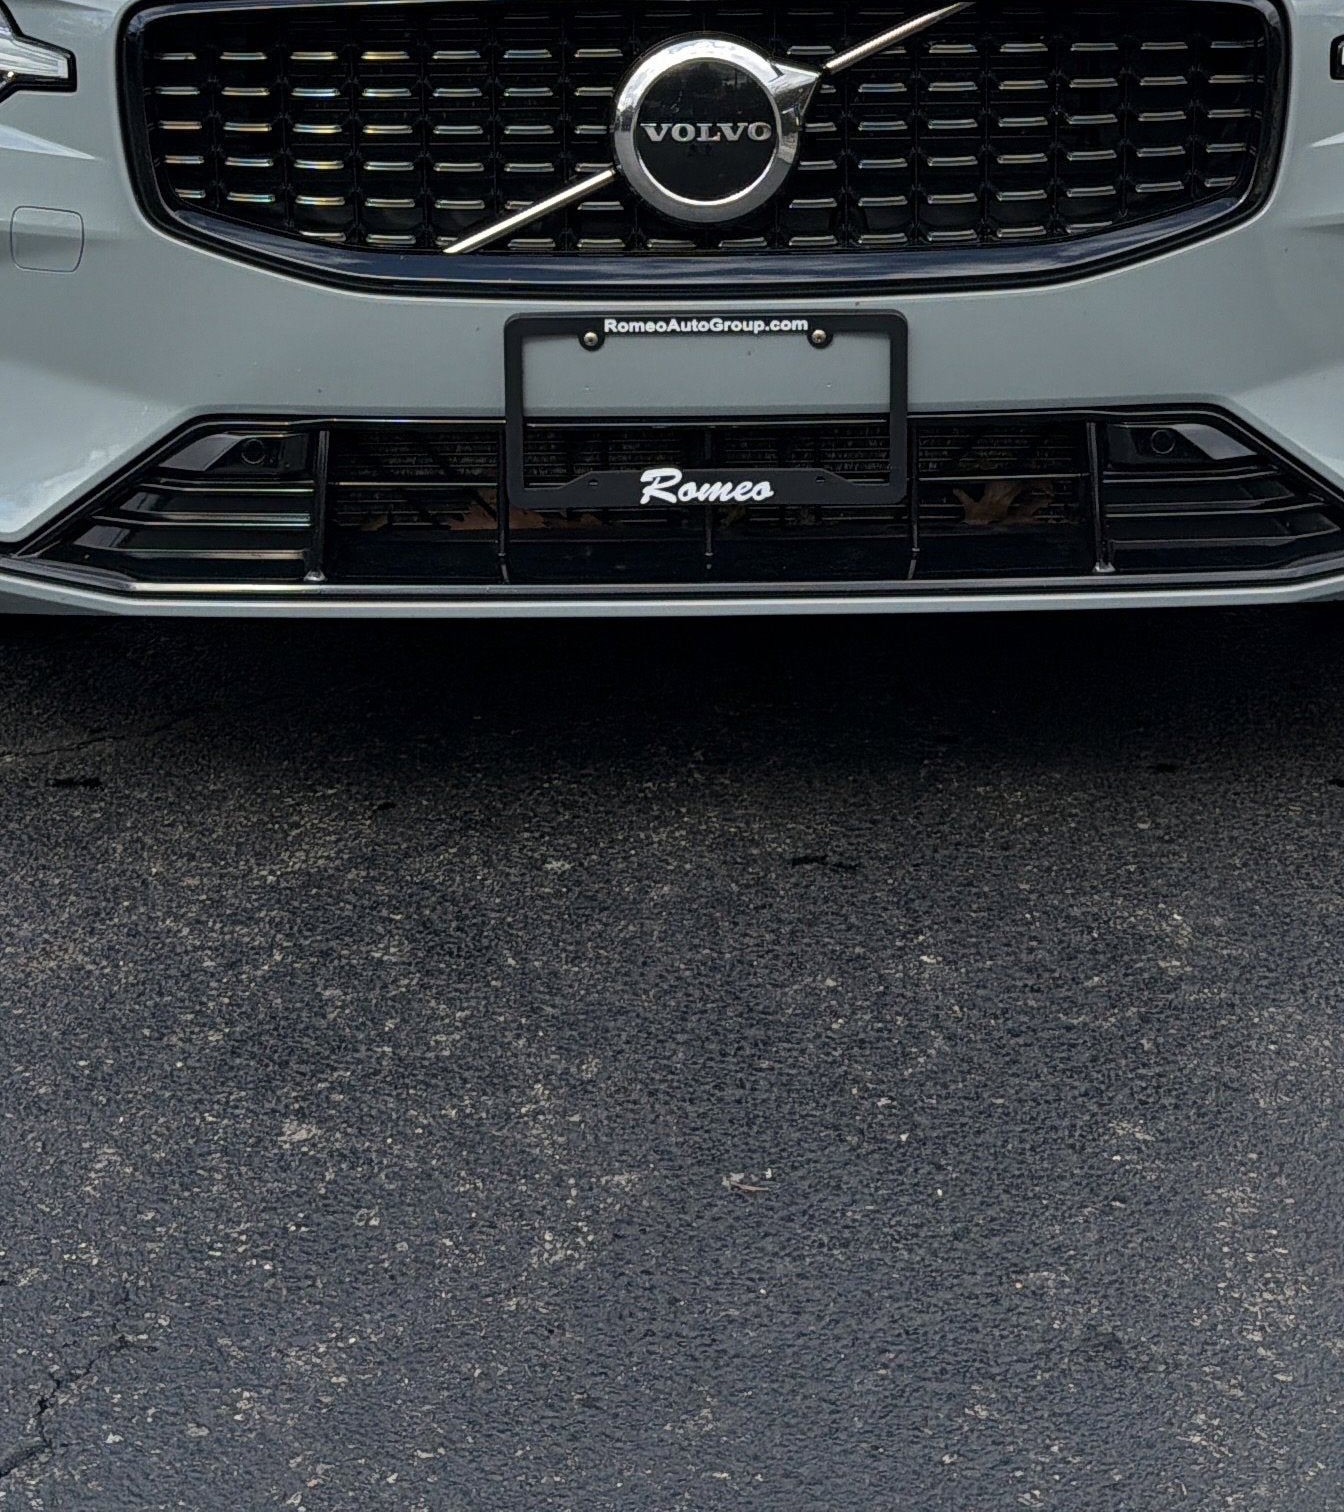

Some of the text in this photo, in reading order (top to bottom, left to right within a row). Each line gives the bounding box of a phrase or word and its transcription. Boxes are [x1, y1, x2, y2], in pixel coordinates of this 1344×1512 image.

[640, 121, 773, 142] VOLVO
[604, 317, 809, 334] RomeoAutoGroup.com
[639, 467, 775, 505] Romeo
